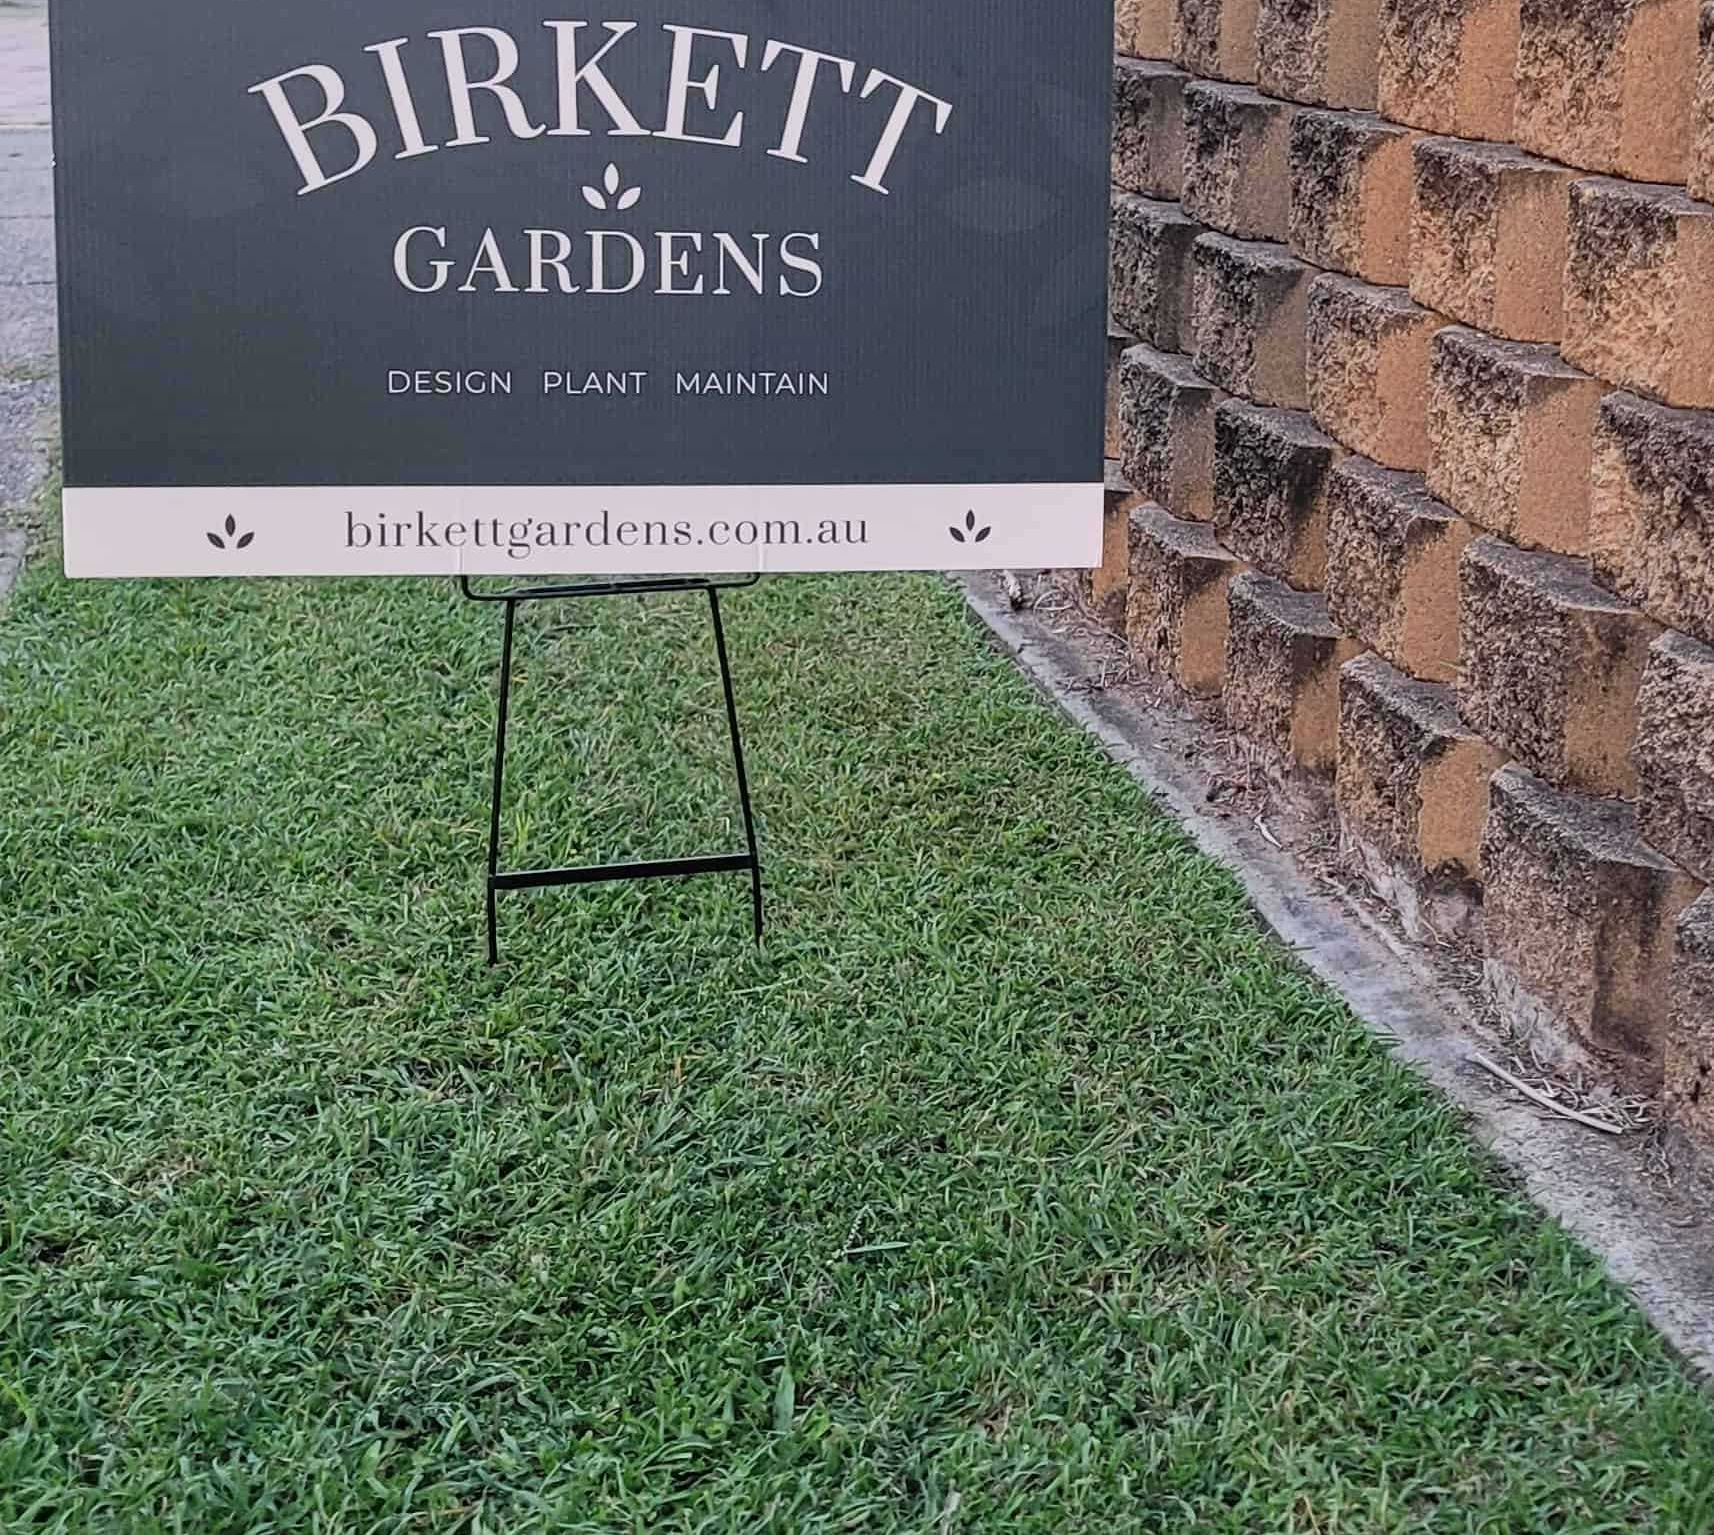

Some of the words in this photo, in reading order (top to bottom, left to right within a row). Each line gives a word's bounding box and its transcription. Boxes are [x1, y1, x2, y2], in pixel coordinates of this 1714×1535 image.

[248, 20, 953, 196] BIRKETT
[393, 226, 823, 297] GARDENS
[388, 370, 512, 395] DESIGN
[543, 371, 647, 395] PLANT
[675, 372, 829, 396] MAINTAIN
[344, 510, 869, 560] birkettgardens.com.au
